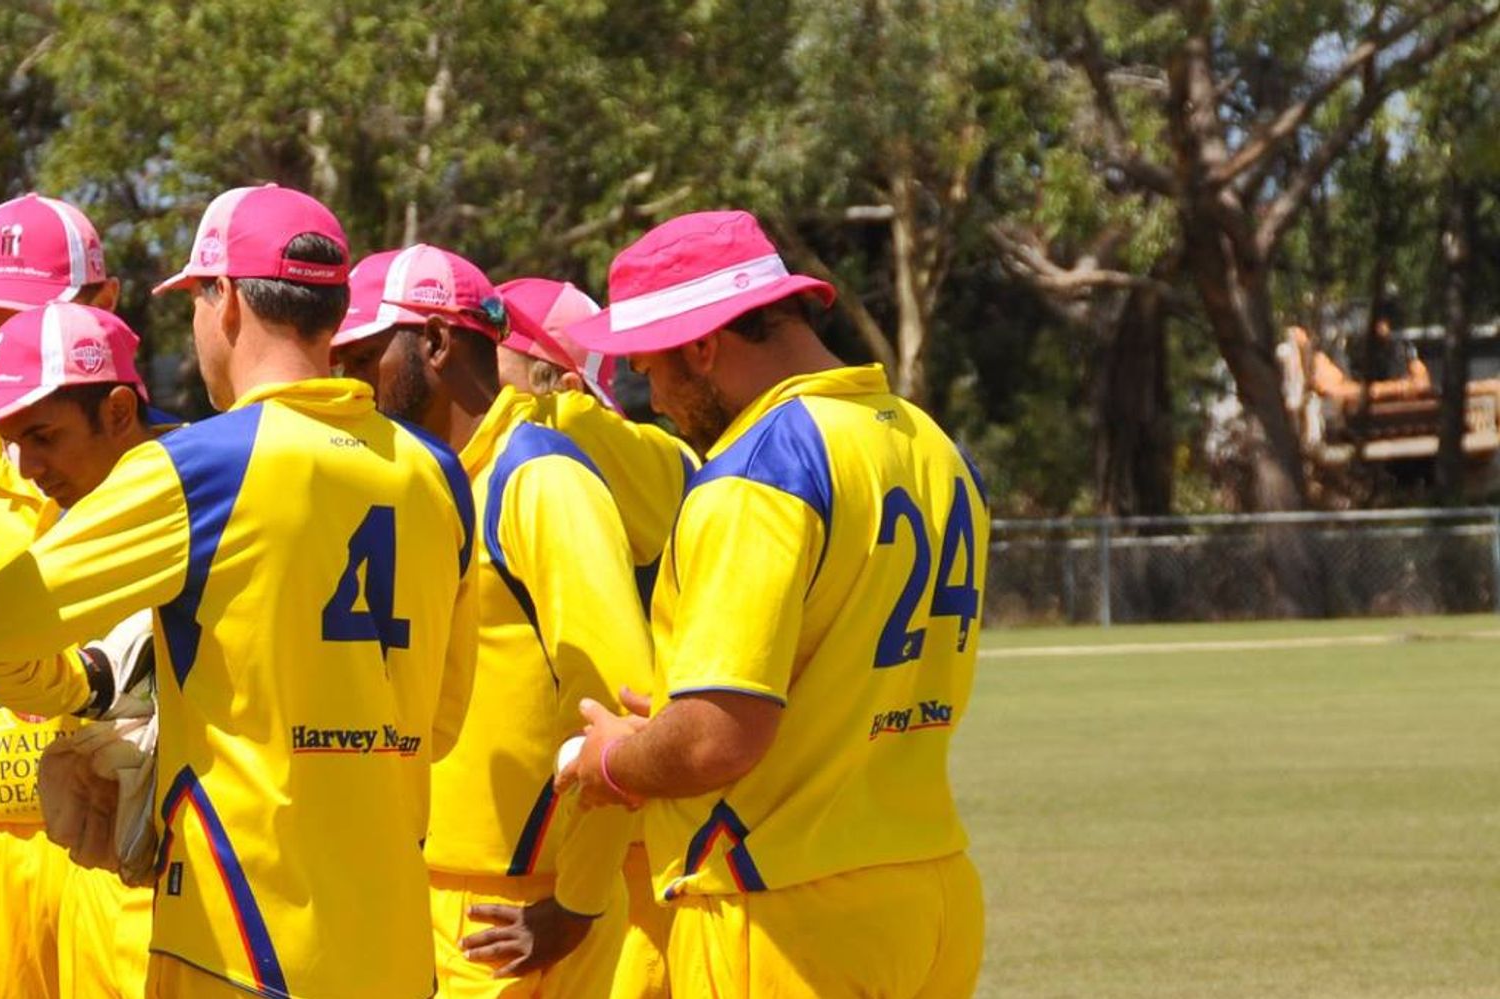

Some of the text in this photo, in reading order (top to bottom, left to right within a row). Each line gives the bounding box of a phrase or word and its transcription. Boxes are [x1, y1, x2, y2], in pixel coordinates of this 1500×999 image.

[321, 504, 411, 658] 4
[873, 476, 980, 668] 24
[292, 725, 377, 753] Harvey
